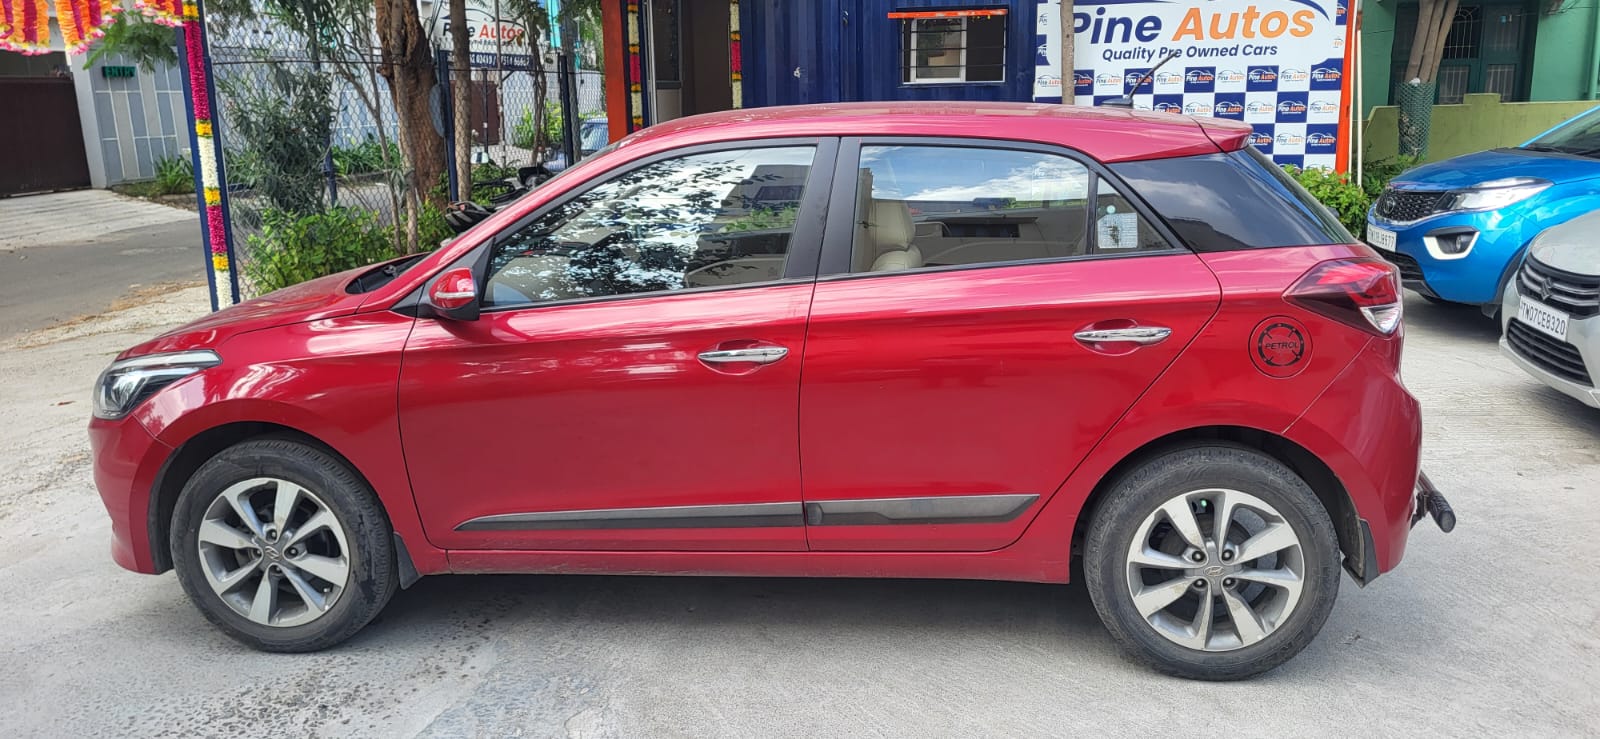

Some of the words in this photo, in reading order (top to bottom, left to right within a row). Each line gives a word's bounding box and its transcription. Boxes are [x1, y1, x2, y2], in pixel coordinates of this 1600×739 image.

[442, 22, 476, 37] Pe
[1073, 7, 1162, 44] Pine
[1172, 6, 1316, 41] Autos
[1102, 46, 1156, 63] Quality
[1159, 46, 1182, 58] Pre
[1186, 44, 1239, 58] Owned
[1242, 44, 1278, 56] Cars
[104, 66, 136, 77] ENTRY
[1522, 302, 1566, 336] TN07CE8320
